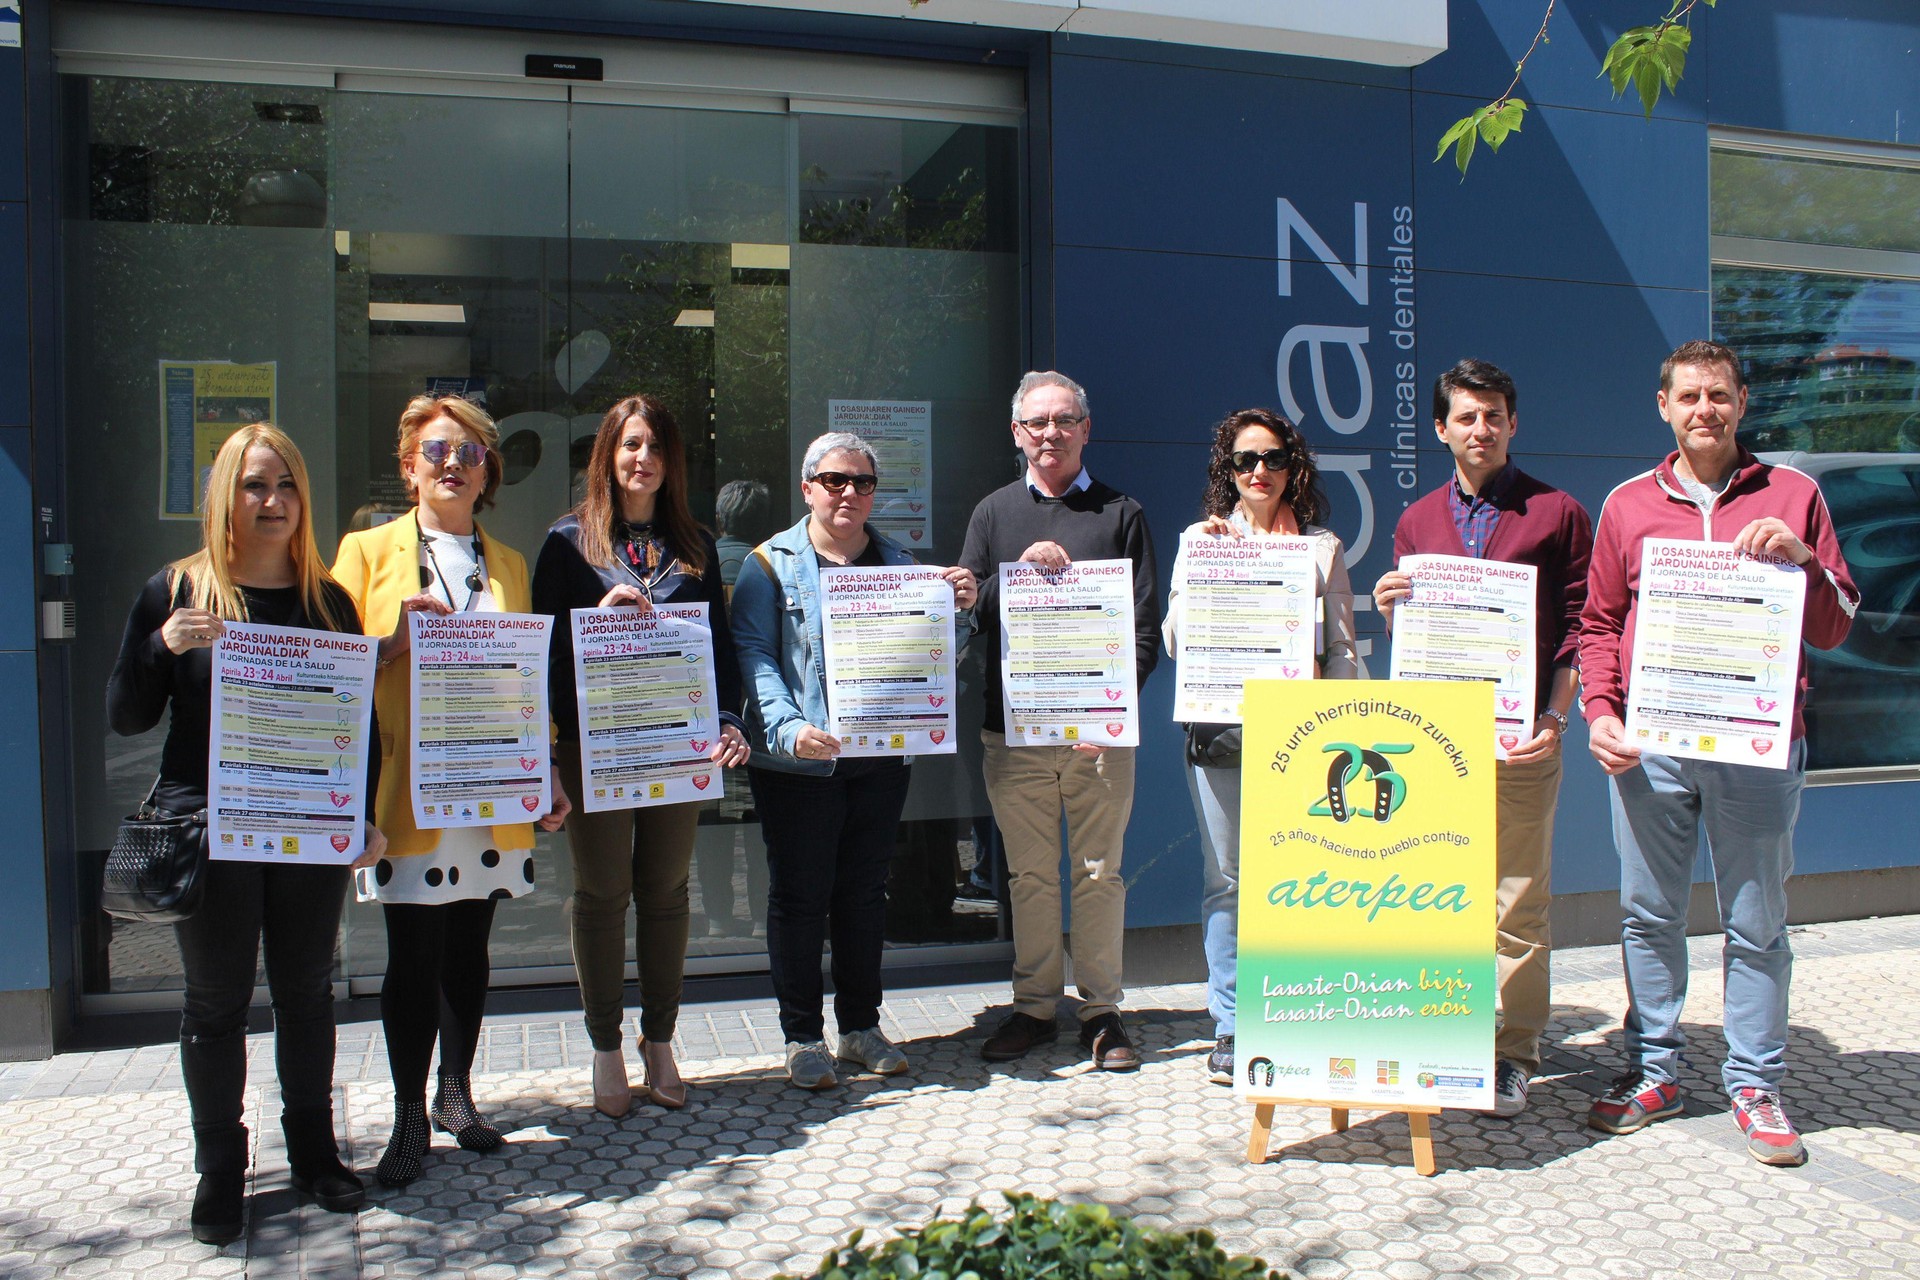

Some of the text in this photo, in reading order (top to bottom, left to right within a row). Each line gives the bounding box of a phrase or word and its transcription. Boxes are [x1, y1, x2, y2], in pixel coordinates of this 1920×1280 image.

[1387, 205, 1418, 489] clínicas dentales
[841, 405, 892, 413] OSASUNAREN
[893, 406, 926, 414] GAINEKO
[1187, 540, 1308, 551] II OSASUNAREN GAINEKO
[1187, 550, 1262, 559] JARDUNALDIAK
[1651, 547, 1659, 555] II
[1661, 547, 1741, 561] OSASUNAREN
[1007, 566, 1125, 577] II OSASUNAREN GAINEKO
[1650, 558, 1739, 572] JARDUNALDIAK
[828, 575, 833, 583] II
[836, 573, 901, 583] OSASUNAREN
[1187, 571, 1206, 579] Apirila
[1207, 568, 1218, 578] 23
[1224, 569, 1235, 578] 24
[1410, 571, 1483, 584] ARDUNALDIAK
[1485, 567, 1529, 581] GAINEKO
[1657, 569, 1705, 579] JORNADAS
[1707, 572, 1720, 580] DE
[1735, 574, 1766, 583] SALUD
[828, 583, 902, 593] JARDUNALDIAK
[1007, 577, 1080, 587] JARDUNALDIAK
[1650, 582, 1671, 591] Apirila
[1673, 580, 1686, 591] 23
[1692, 581, 1705, 592] 24
[1455, 583, 1466, 591] DE
[1479, 586, 1504, 595] SALUD
[834, 593, 875, 601] JORNADAS
[1028, 596, 1039, 605] 23
[1044, 595, 1055, 605] 24
[1425, 591, 1437, 601] 23
[1442, 592, 1454, 601] 24
[830, 605, 848, 613] Apirila
[850, 602, 861, 612] 23
[866, 601, 877, 611] 24
[579, 609, 701, 625] II OSASUNAREN GAINEKO
[417, 619, 544, 630] II OSASUNAREN GAINEKO
[580, 621, 658, 636] JARDUNALDIAK
[230, 630, 311, 647] OSASUNAREN
[313, 639, 368, 653] GAINEKO
[418, 630, 495, 640] JARDUNALDIAK
[587, 633, 630, 644] JORNADAS
[643, 632, 654, 640] LA
[655, 630, 680, 638] SALUD
[220, 641, 309, 659] JARDUNALDIAK
[425, 641, 467, 649] JORNADAS
[492, 641, 517, 649] SALUD
[583, 648, 602, 657] Apirila
[603, 644, 615, 655] 23
[620, 643, 632, 654] 24
[227, 654, 273, 667] JORNADAS
[275, 659, 288, 668] DE
[290, 661, 302, 669] LA
[304, 662, 336, 671] SALUD
[419, 654, 439, 663] Apirila
[441, 651, 452, 662] 23
[457, 651, 469, 662] 24
[221, 666, 293, 682] Apirila 23 24 Abril
[1271, 698, 1469, 778] 25 urte herrigintzan zurekin
[1269, 828, 1470, 860] 25 años haciendo pueblo contigo
[1267, 870, 1472, 923] aterpea
[1262, 967, 1473, 997] Lasarte-Orian bizi,
[1264, 997, 1414, 1023] Lasarte-Orian
